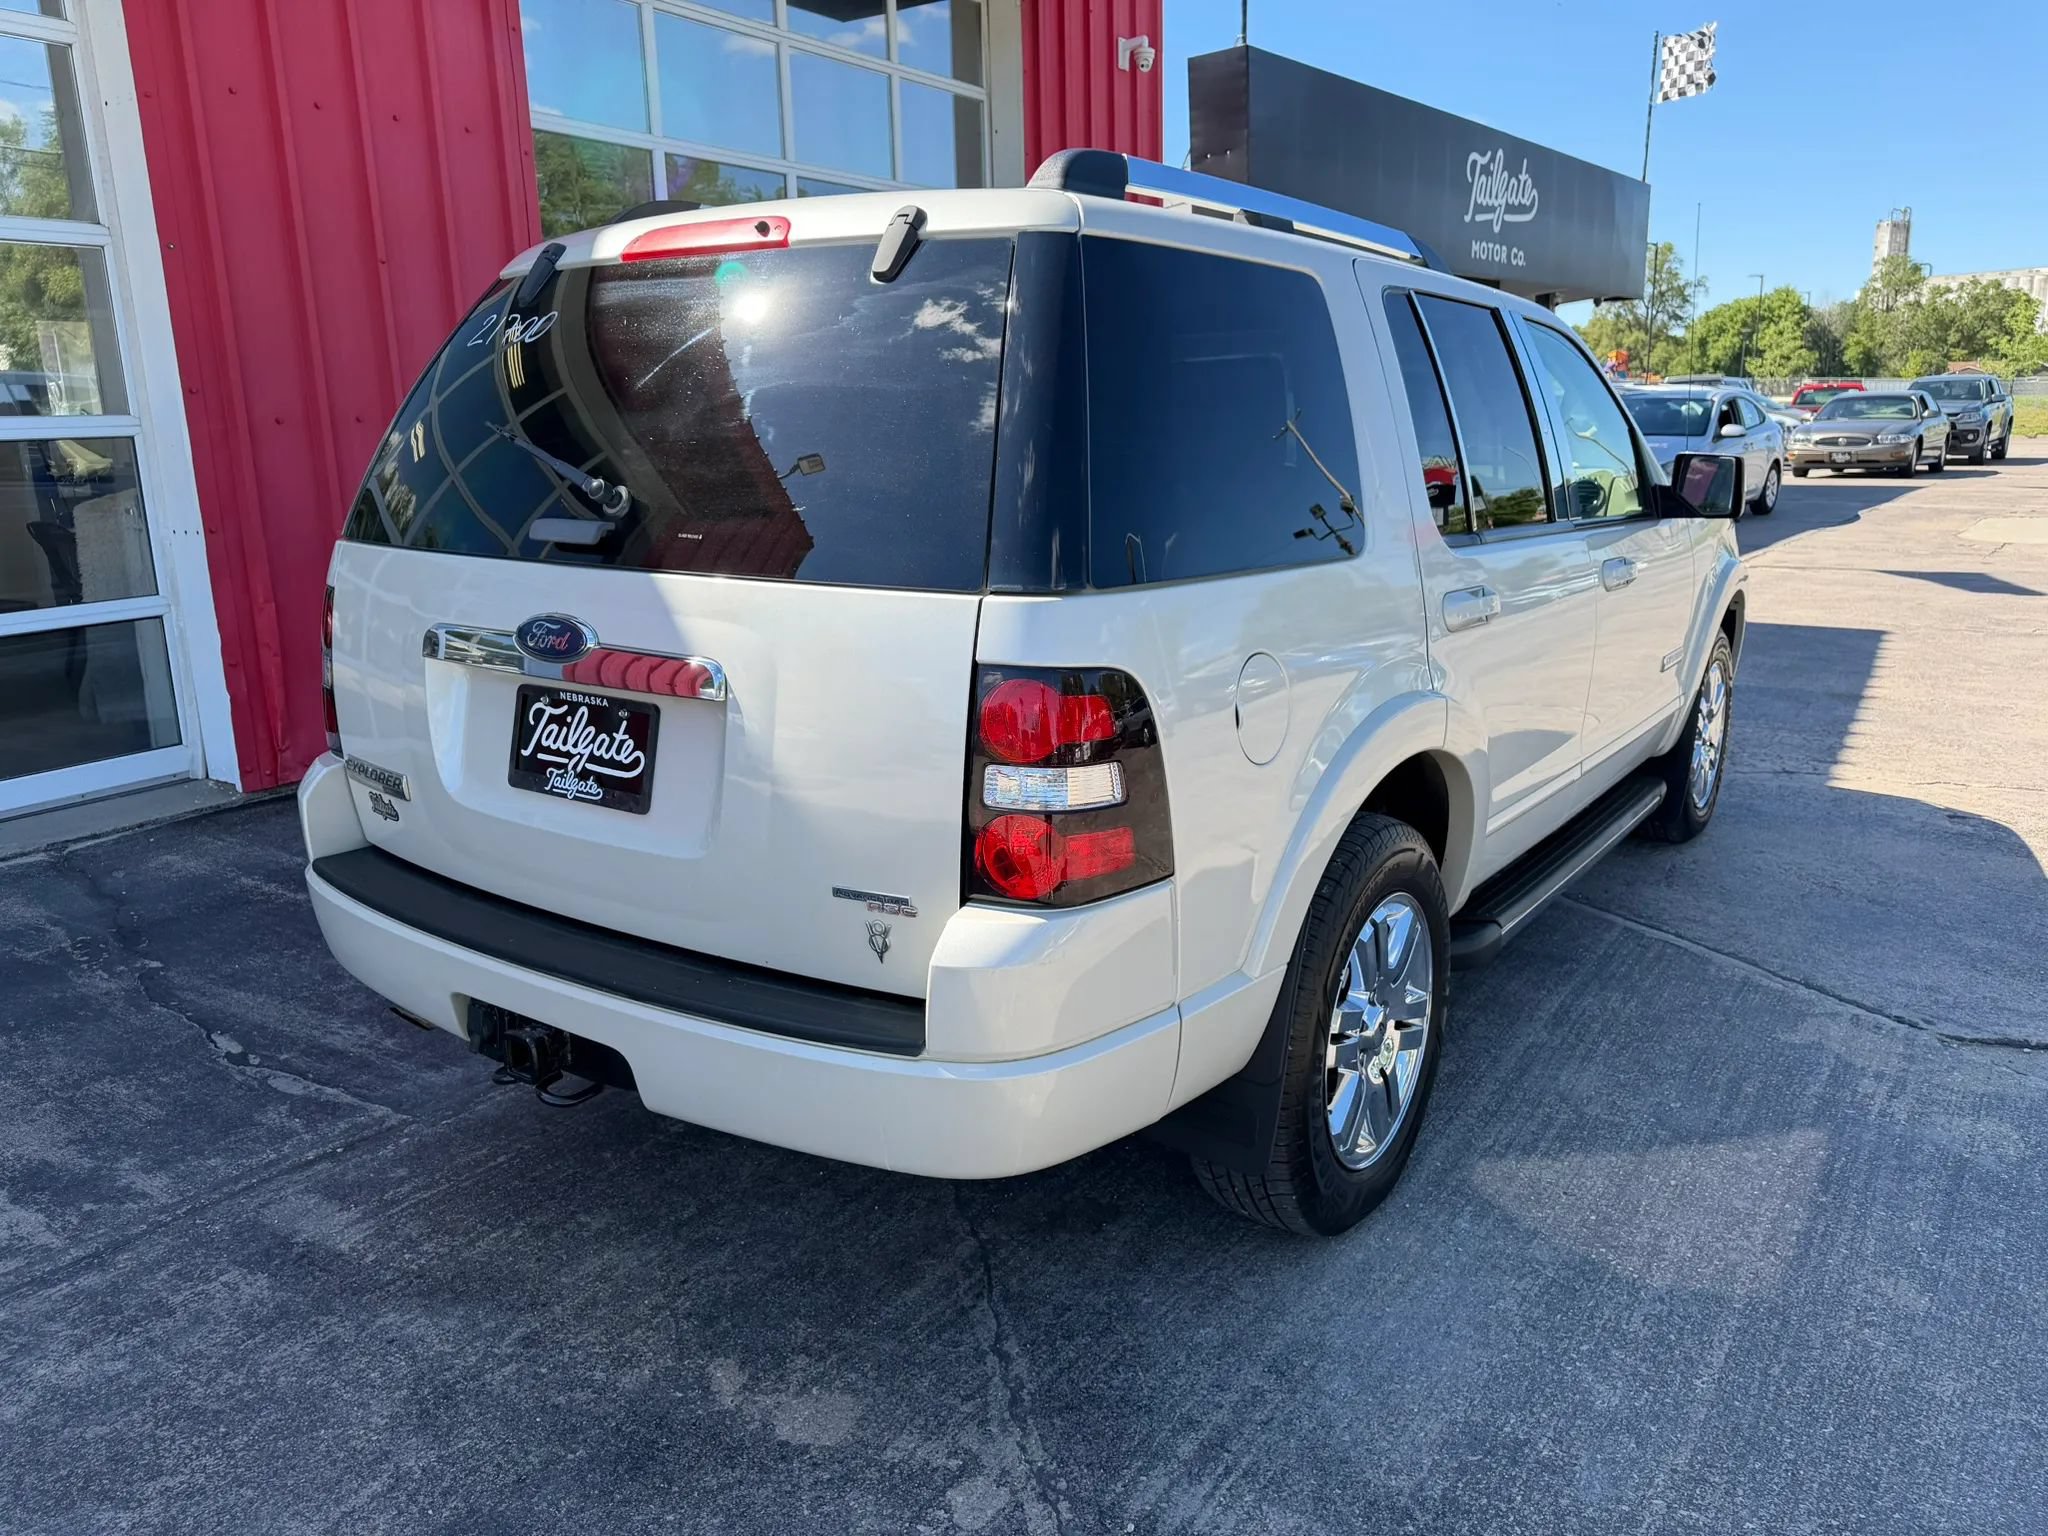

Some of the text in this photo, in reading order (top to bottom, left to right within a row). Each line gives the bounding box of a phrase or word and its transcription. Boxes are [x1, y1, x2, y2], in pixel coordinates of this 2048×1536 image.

[1464, 148, 1538, 233] Tailgate
[1472, 240, 1526, 266] MOTOR CO.
[527, 620, 570, 650] Ford
[559, 691, 609, 707] NEBRASKA
[521, 702, 645, 778] Tailgate
[345, 759, 402, 789] EXPLORER
[544, 767, 603, 799] Tailgate
